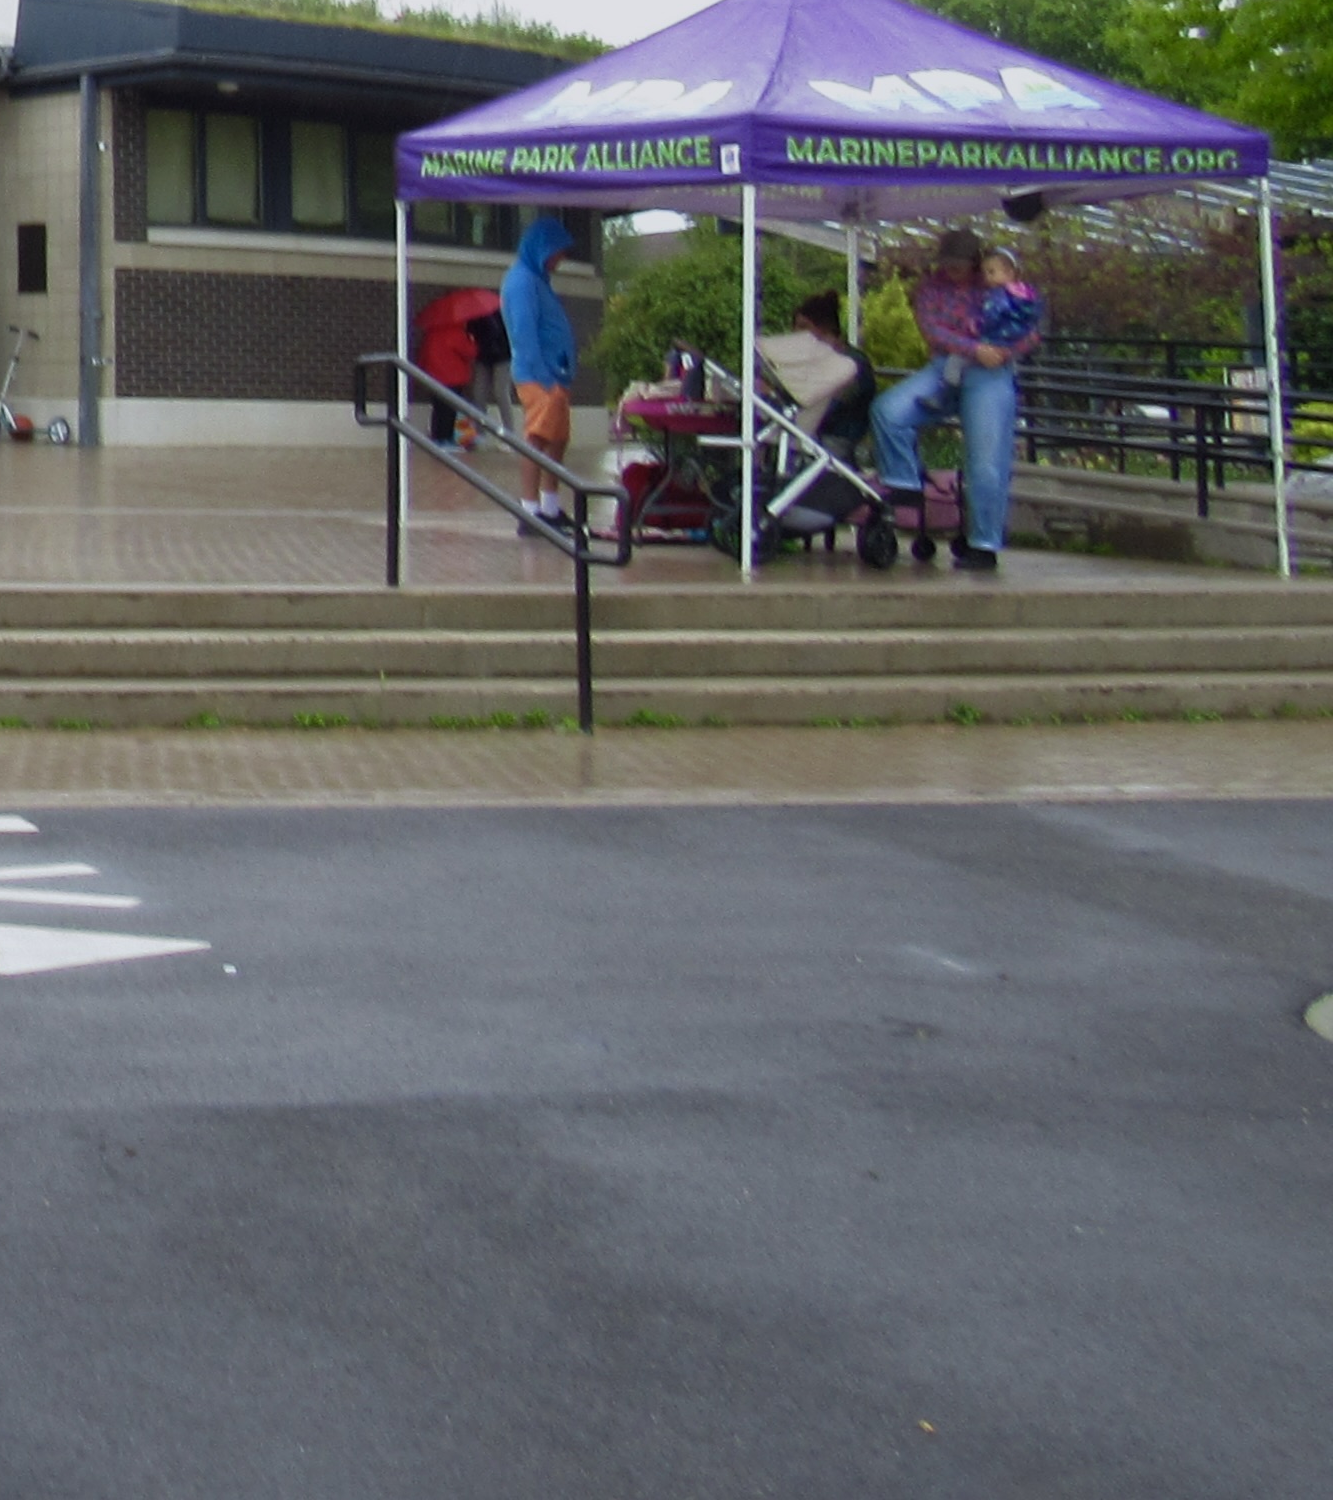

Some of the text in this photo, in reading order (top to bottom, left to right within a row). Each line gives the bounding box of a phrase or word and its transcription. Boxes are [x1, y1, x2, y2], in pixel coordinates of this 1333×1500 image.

[421, 135, 712, 177] MARINE PARK ALLIANCE
[787, 135, 1238, 174] MARINEPARKALLIANCE.ORG
